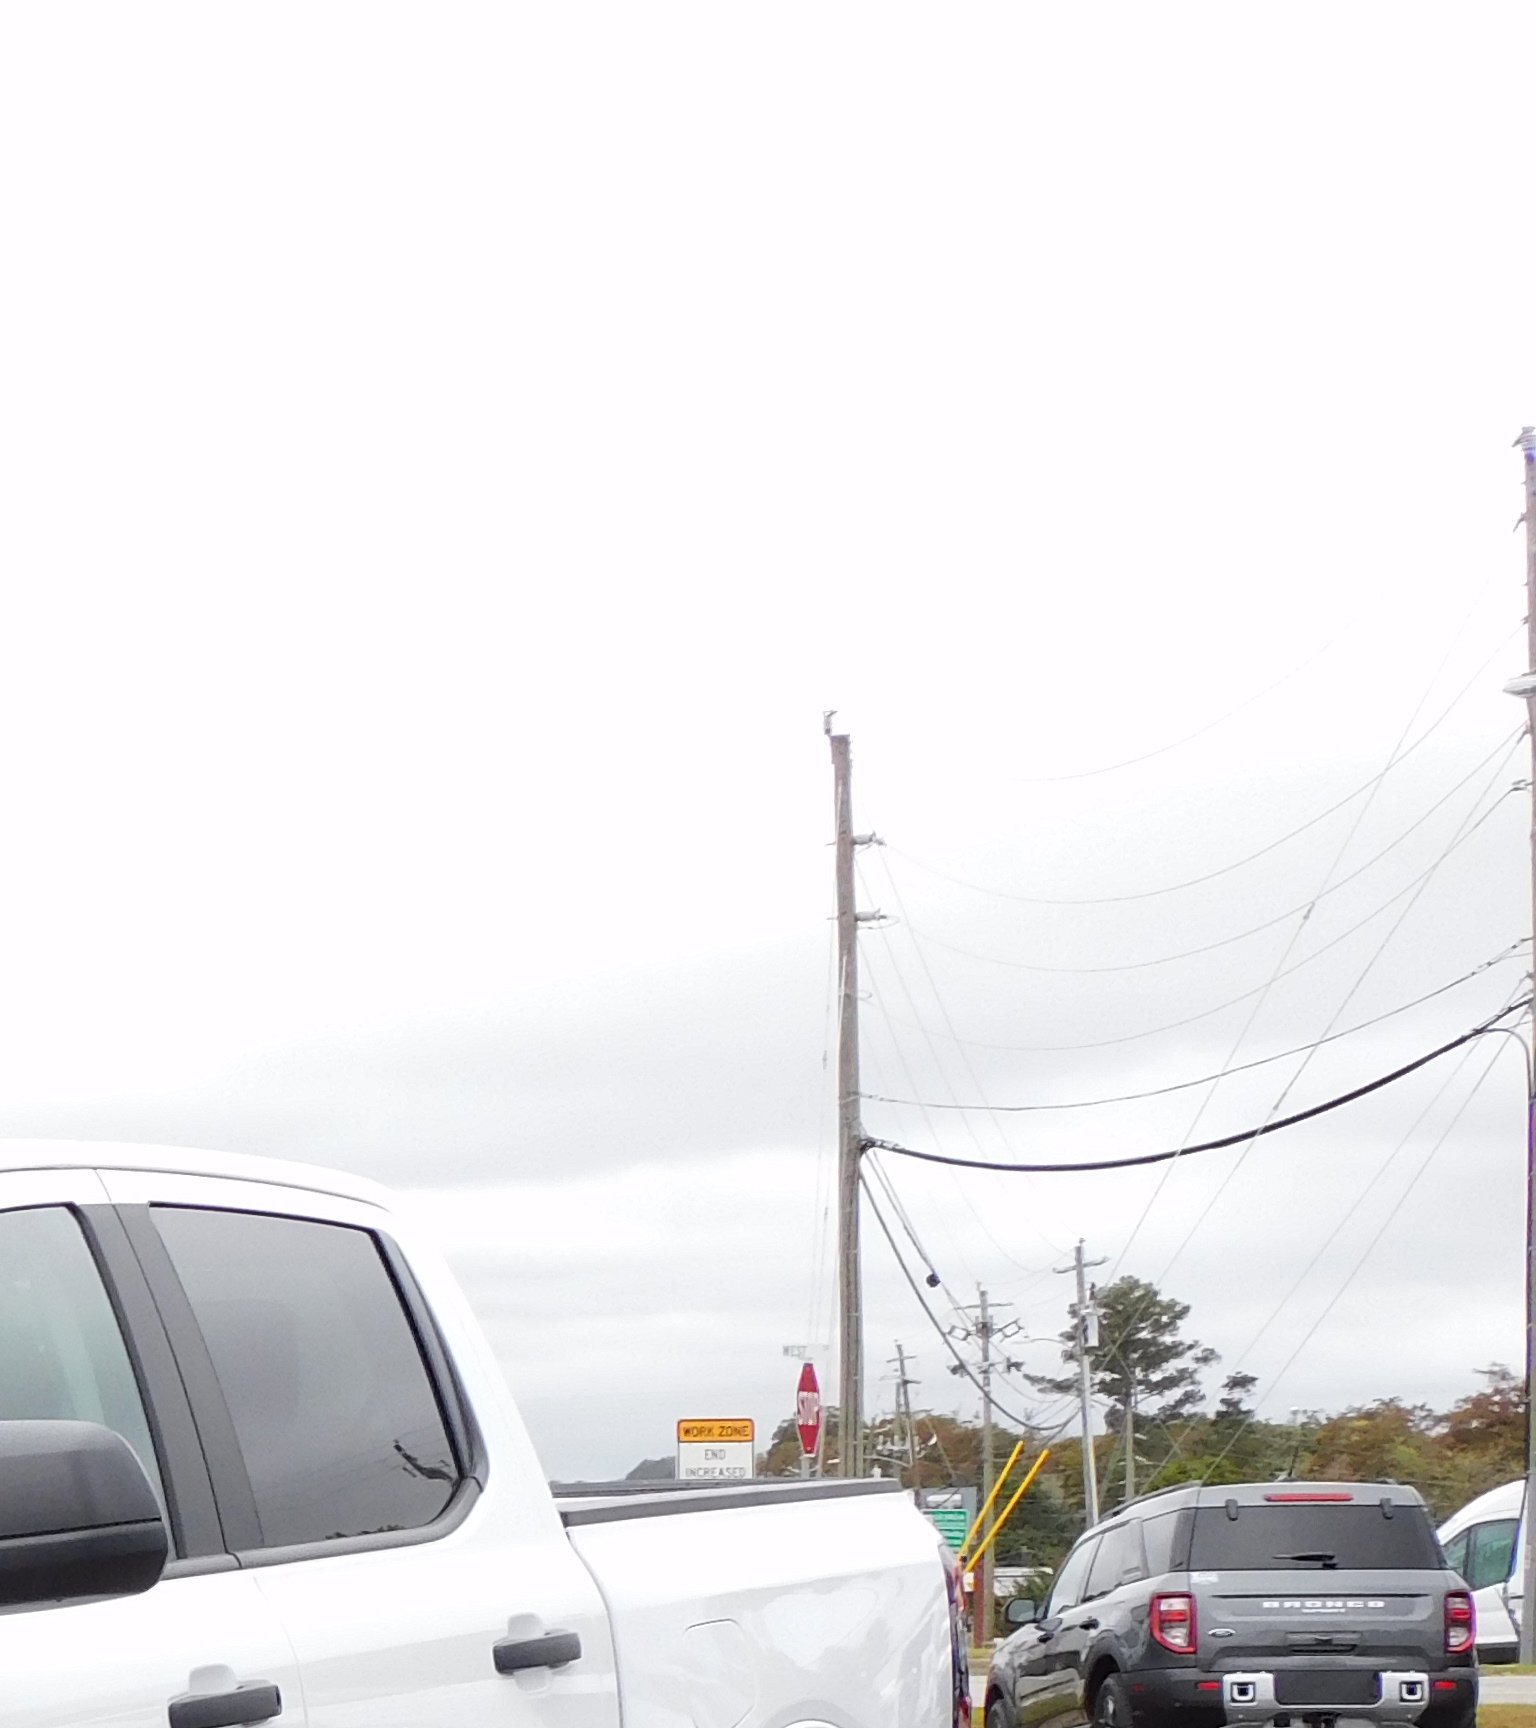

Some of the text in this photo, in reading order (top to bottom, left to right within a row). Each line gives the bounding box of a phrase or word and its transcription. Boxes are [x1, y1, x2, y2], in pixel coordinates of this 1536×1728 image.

[797, 1390, 819, 1425] STOP
[683, 1425, 750, 1437] WORK ZONE
[704, 1449, 726, 1460] END
[685, 1467, 746, 1479] INCREASED
